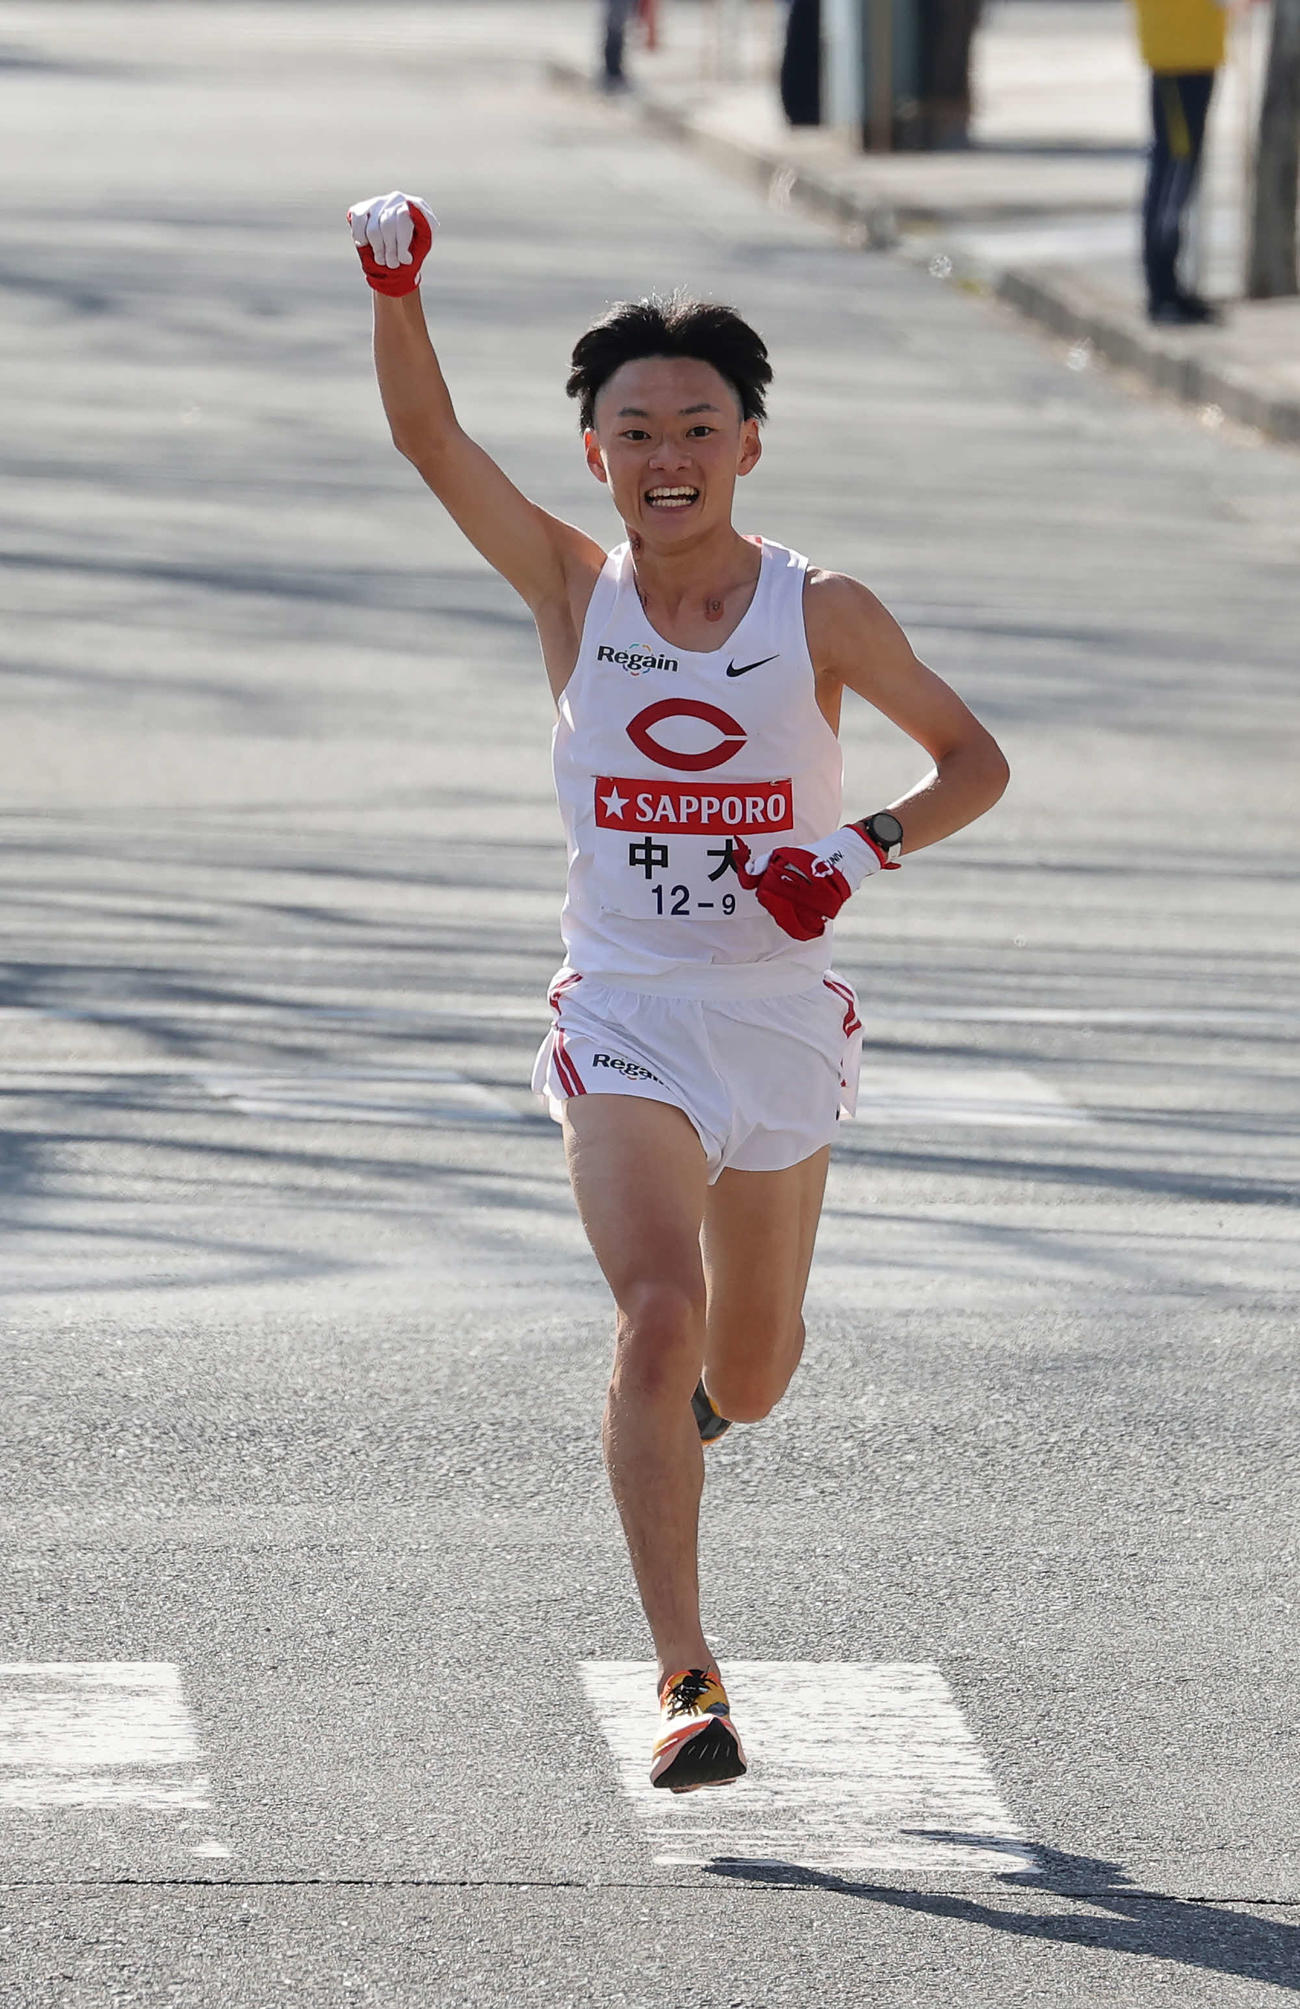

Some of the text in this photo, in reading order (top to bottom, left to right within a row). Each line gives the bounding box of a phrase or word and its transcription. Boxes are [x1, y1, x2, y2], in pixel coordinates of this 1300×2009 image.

[597, 645, 678, 672] Regain
[635, 793, 786, 825] SAPPORO
[592, 1053, 670, 1090] Rega
